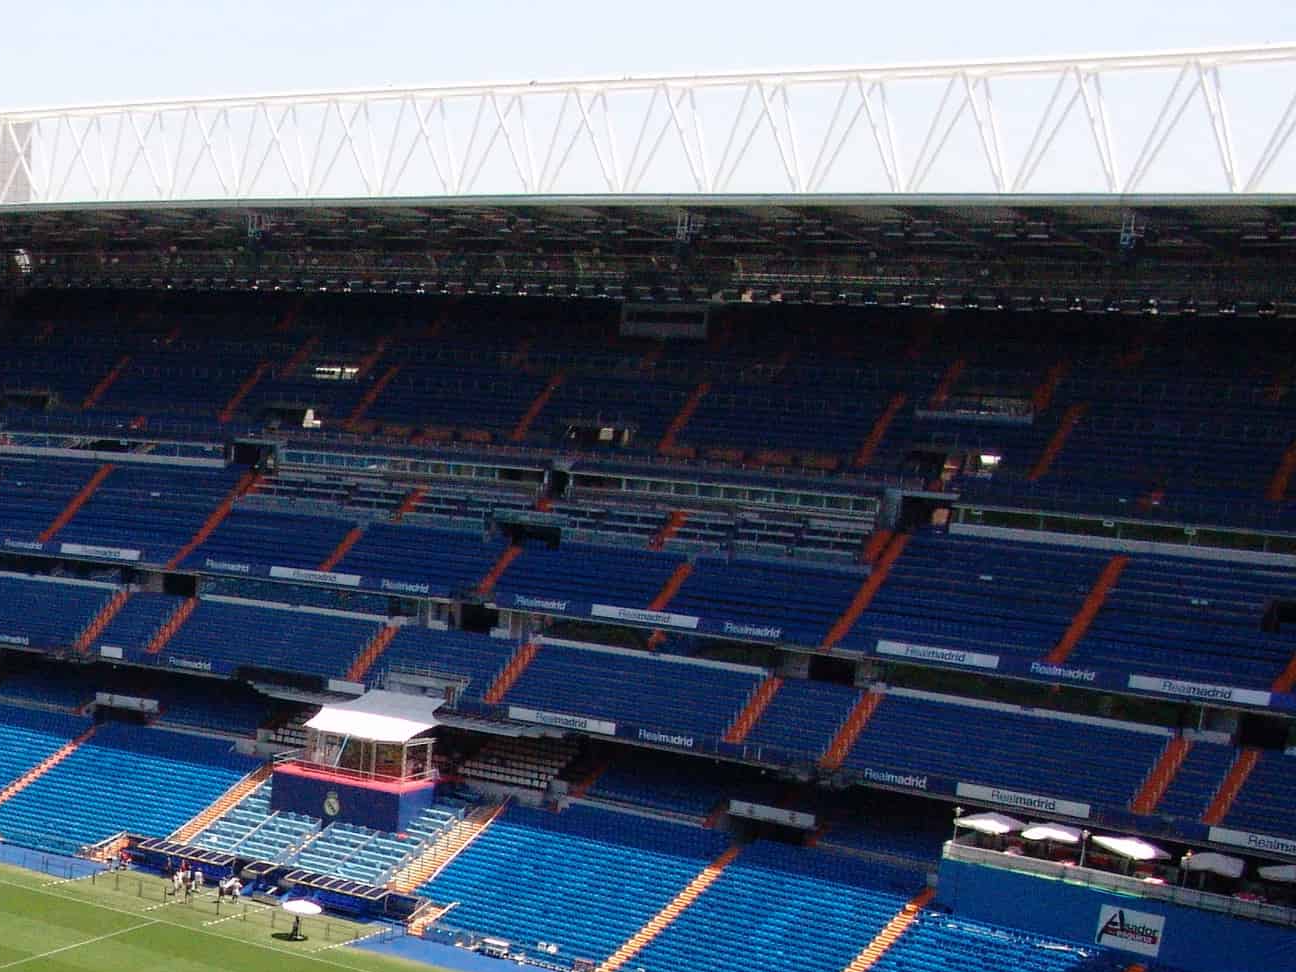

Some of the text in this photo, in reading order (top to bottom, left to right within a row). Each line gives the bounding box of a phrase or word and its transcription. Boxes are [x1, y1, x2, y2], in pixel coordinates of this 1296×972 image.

[725, 622, 781, 638] Realmadrid
[1030, 662, 1095, 681] Realmadrid
[1161, 680, 1232, 699] Realmadrid
[638, 728, 693, 747] Realmadrid
[864, 768, 927, 788] Realmadrid
[991, 789, 1056, 811] Realmadrid
